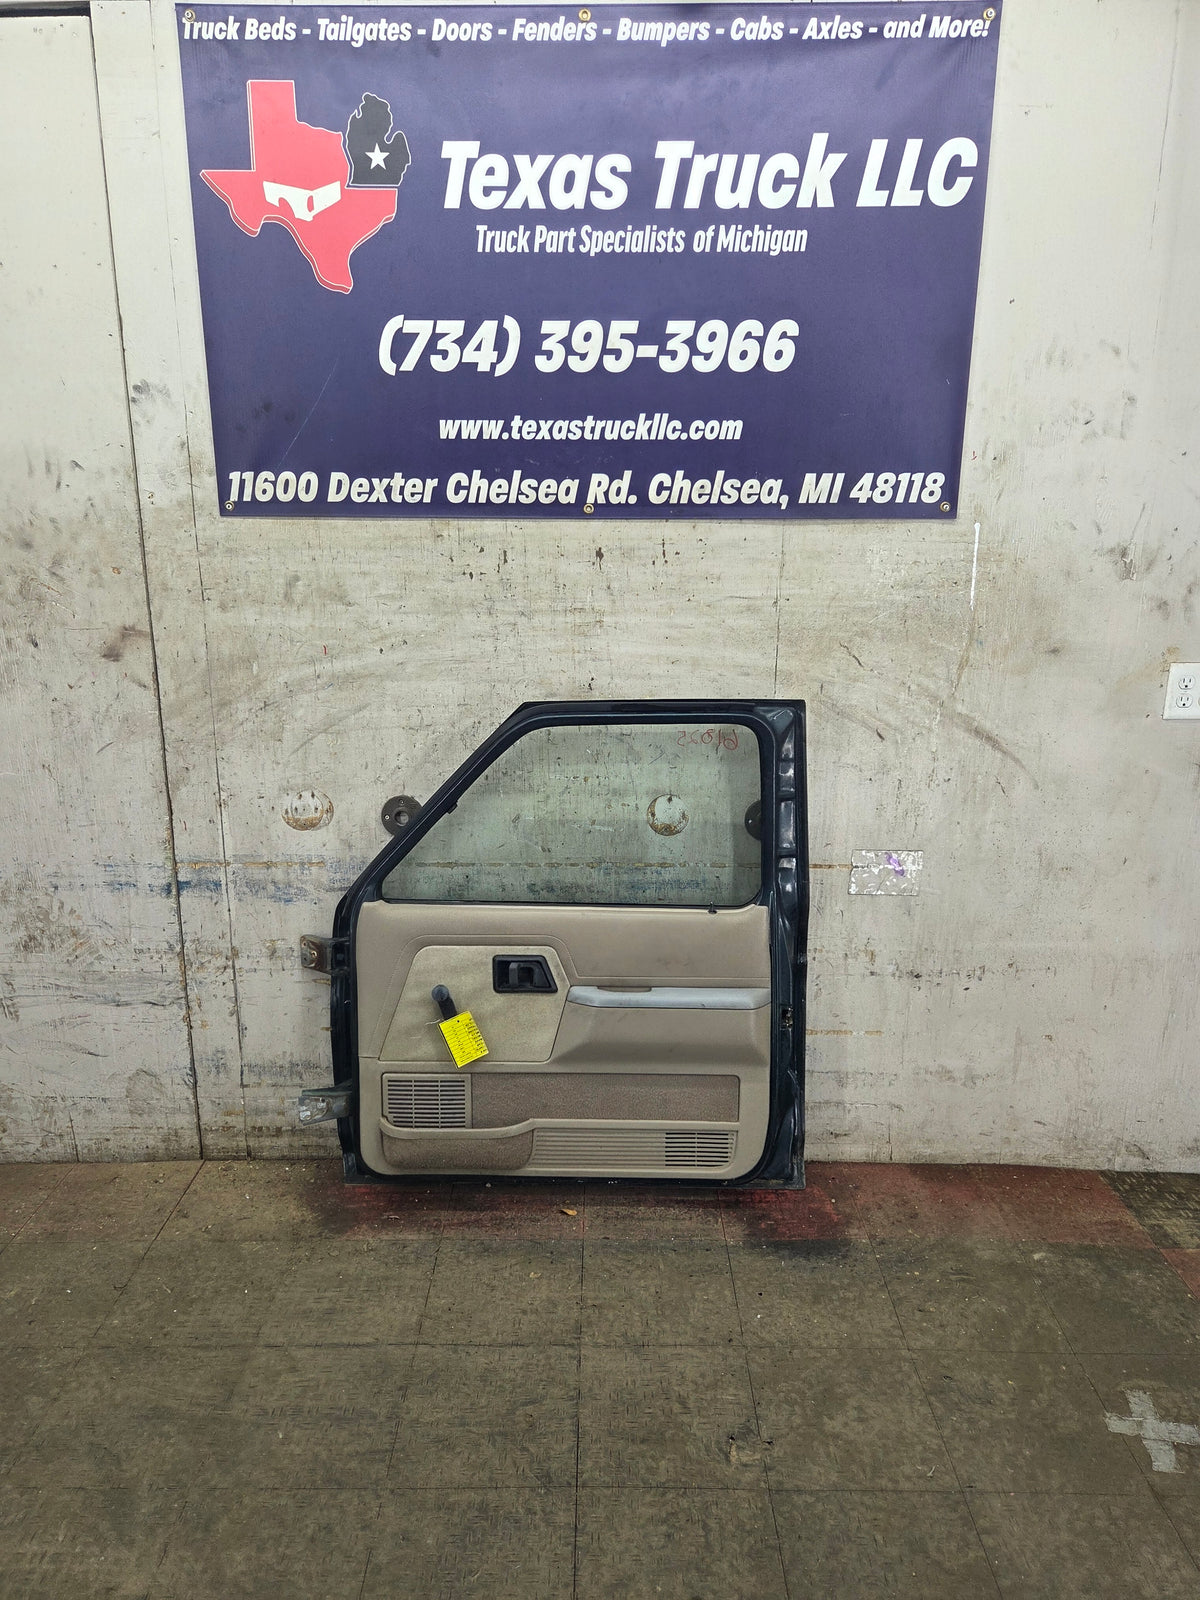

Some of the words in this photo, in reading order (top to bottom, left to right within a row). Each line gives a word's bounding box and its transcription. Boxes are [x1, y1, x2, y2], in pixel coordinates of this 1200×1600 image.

[182, 15, 241, 40] Truck
[244, 16, 298, 41] Beds
[317, 15, 413, 48] Tailgates
[431, 17, 494, 42] Doors
[511, 15, 598, 42] Fenders
[616, 17, 711, 48] Bumpers
[729, 14, 785, 41] Cabs
[801, 14, 864, 40] Axles
[868, 26, 879, 34] -
[882, 13, 927, 39] and
[927, 15, 991, 39] More!
[440, 140, 632, 211] Texas
[654, 132, 848, 210] Truck
[855, 136, 979, 208] LLC
[475, 224, 531, 253] Truck
[533, 224, 577, 254] Part
[578, 224, 686, 257] Specialists
[692, 224, 716, 253] of
[716, 224, 808, 257] Michigan
[378, 314, 521, 377] (734)
[534, 318, 800, 373] 395-3966
[439, 412, 744, 441] www.texastruckllc.com
[228, 470, 319, 503] 11600
[327, 471, 439, 504] Dexter
[446, 469, 580, 504] Chelsea
[586, 470, 638, 505] Rd.
[648, 470, 789, 510] Chelsea,
[798, 472, 846, 504] MI
[849, 471, 946, 504] 48118
